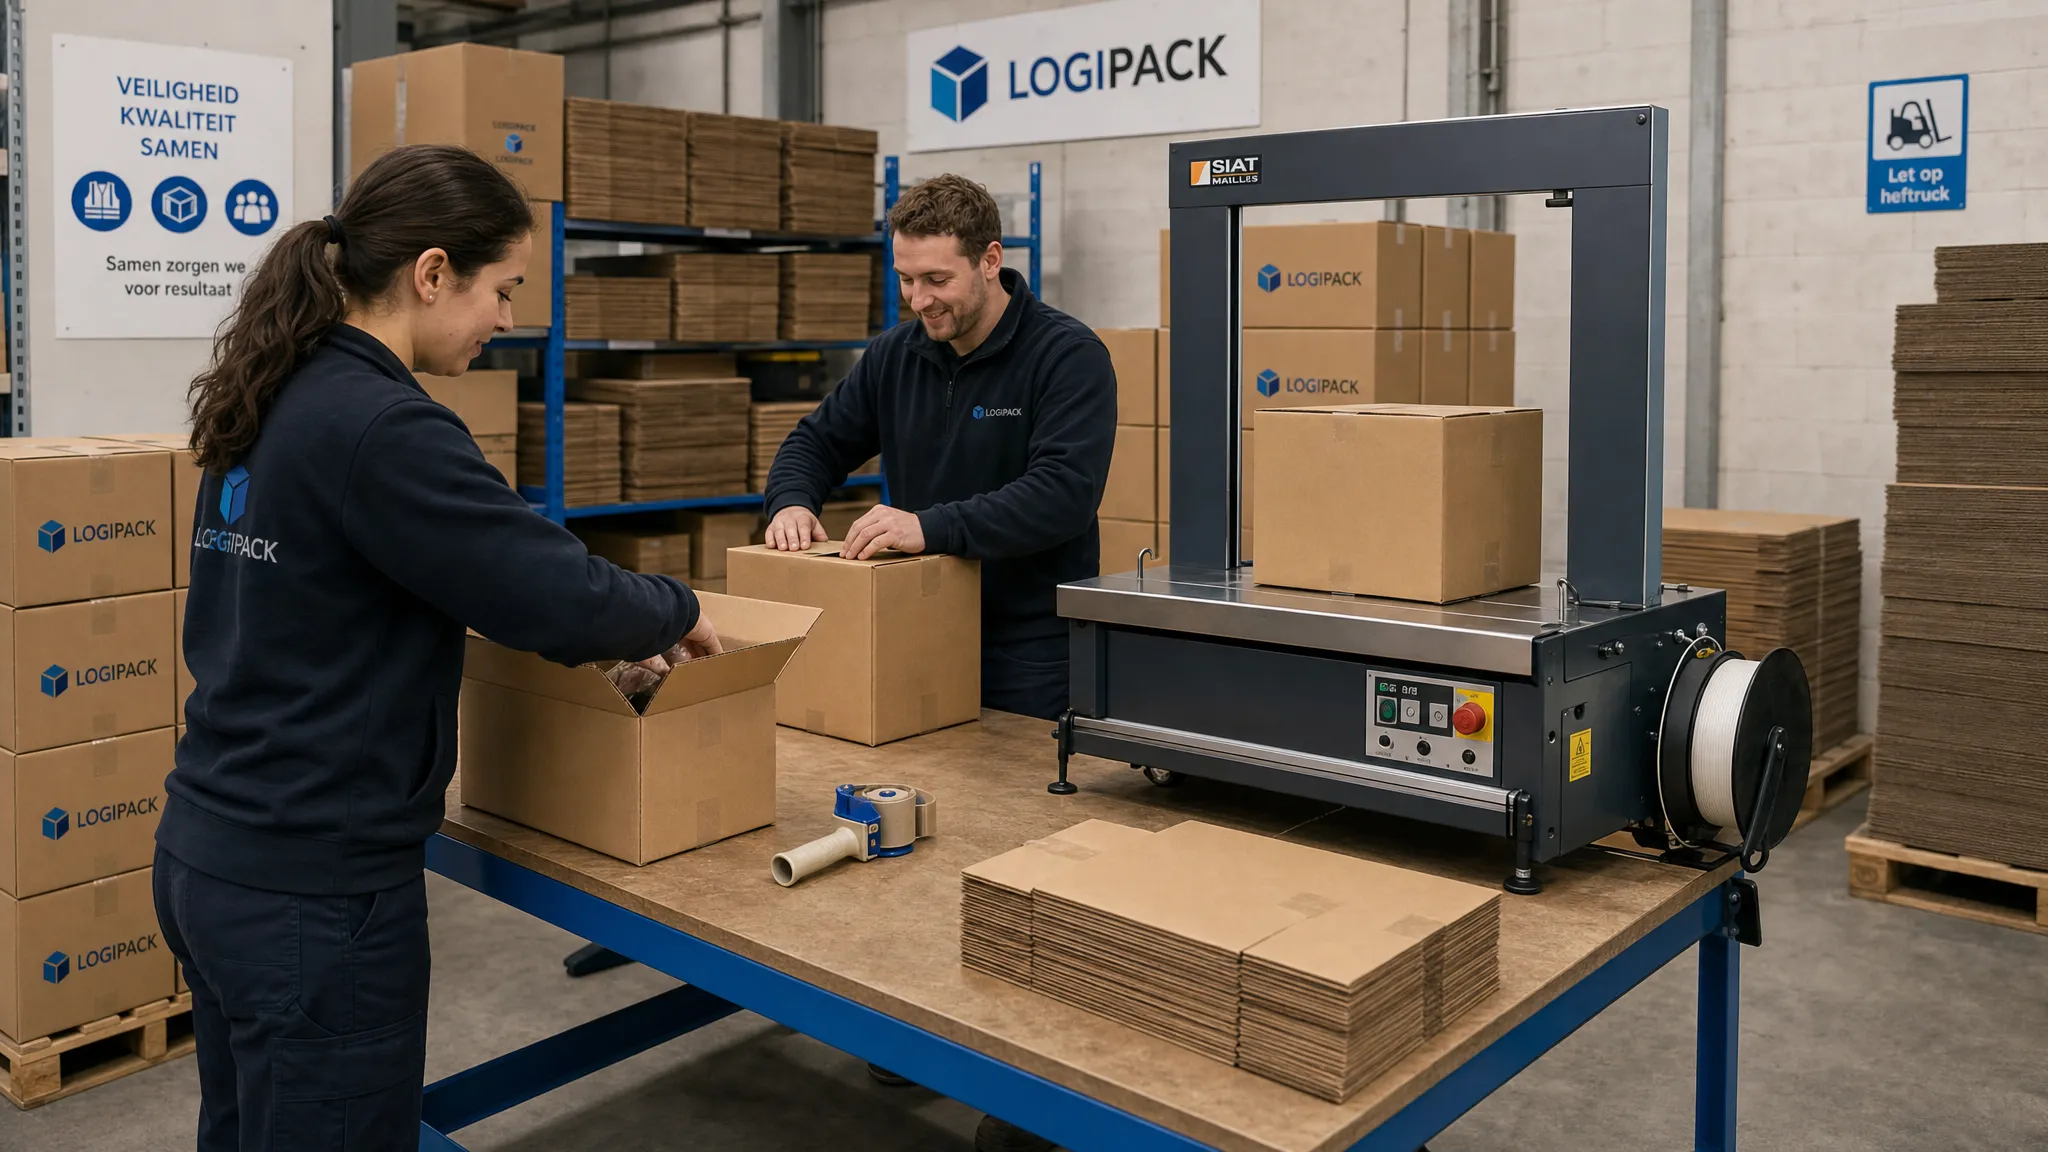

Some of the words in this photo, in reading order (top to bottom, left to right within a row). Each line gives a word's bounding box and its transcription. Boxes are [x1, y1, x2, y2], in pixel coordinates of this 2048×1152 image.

[1009, 34, 1228, 100] LOGIPACK
[117, 76, 239, 104] VEILIGHEID
[120, 107, 237, 133] KWALITEIT
[141, 137, 219, 160] SAMEN
[1212, 157, 1259, 174] SIAT
[1888, 167, 1916, 183] Let
[1920, 168, 1944, 185] op
[1881, 185, 1950, 204] heftruck
[106, 255, 161, 271] Samen
[166, 260, 219, 277] zorgen
[224, 261, 246, 274] we
[124, 283, 160, 296] voor
[165, 281, 232, 297] resultaat
[1287, 271, 1362, 287] LOGIPACK
[1286, 378, 1360, 394] LOGIPACK
[985, 408, 1022, 417] LOGIPACK
[73, 519, 157, 543] LOGIPACK
[76, 658, 158, 687] LOGIPACK
[77, 795, 159, 828] LOGIPACK
[77, 933, 158, 970] LOGIPACK
